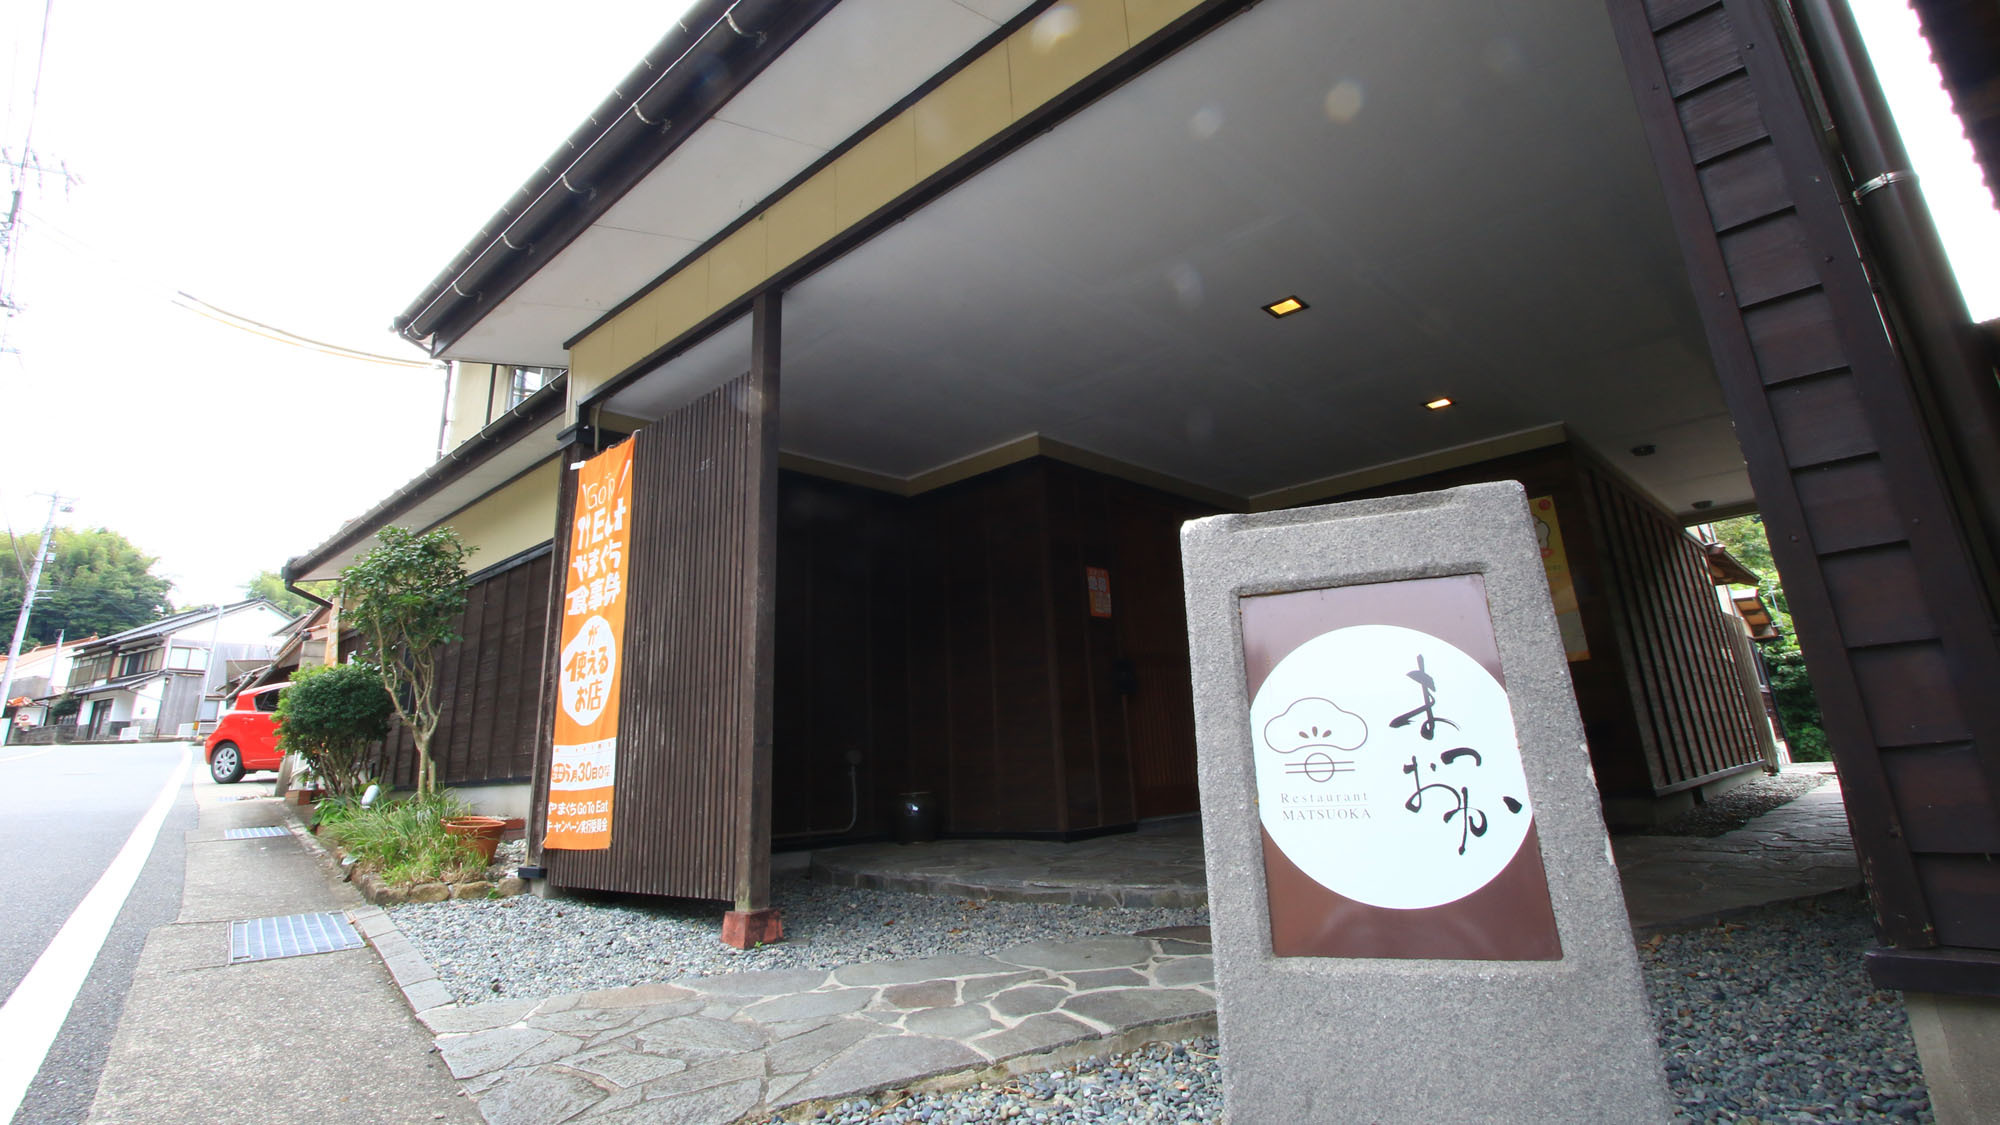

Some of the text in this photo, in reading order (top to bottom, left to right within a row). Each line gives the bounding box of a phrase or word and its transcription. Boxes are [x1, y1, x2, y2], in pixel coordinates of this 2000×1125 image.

[572, 539, 622, 582] やまぐち
[566, 570, 621, 616] 食事券
[565, 646, 609, 683] 使える
[575, 679, 603, 713] お店
[1281, 792, 1369, 805] Restaurant
[1282, 808, 1372, 821] MATSUOKA
